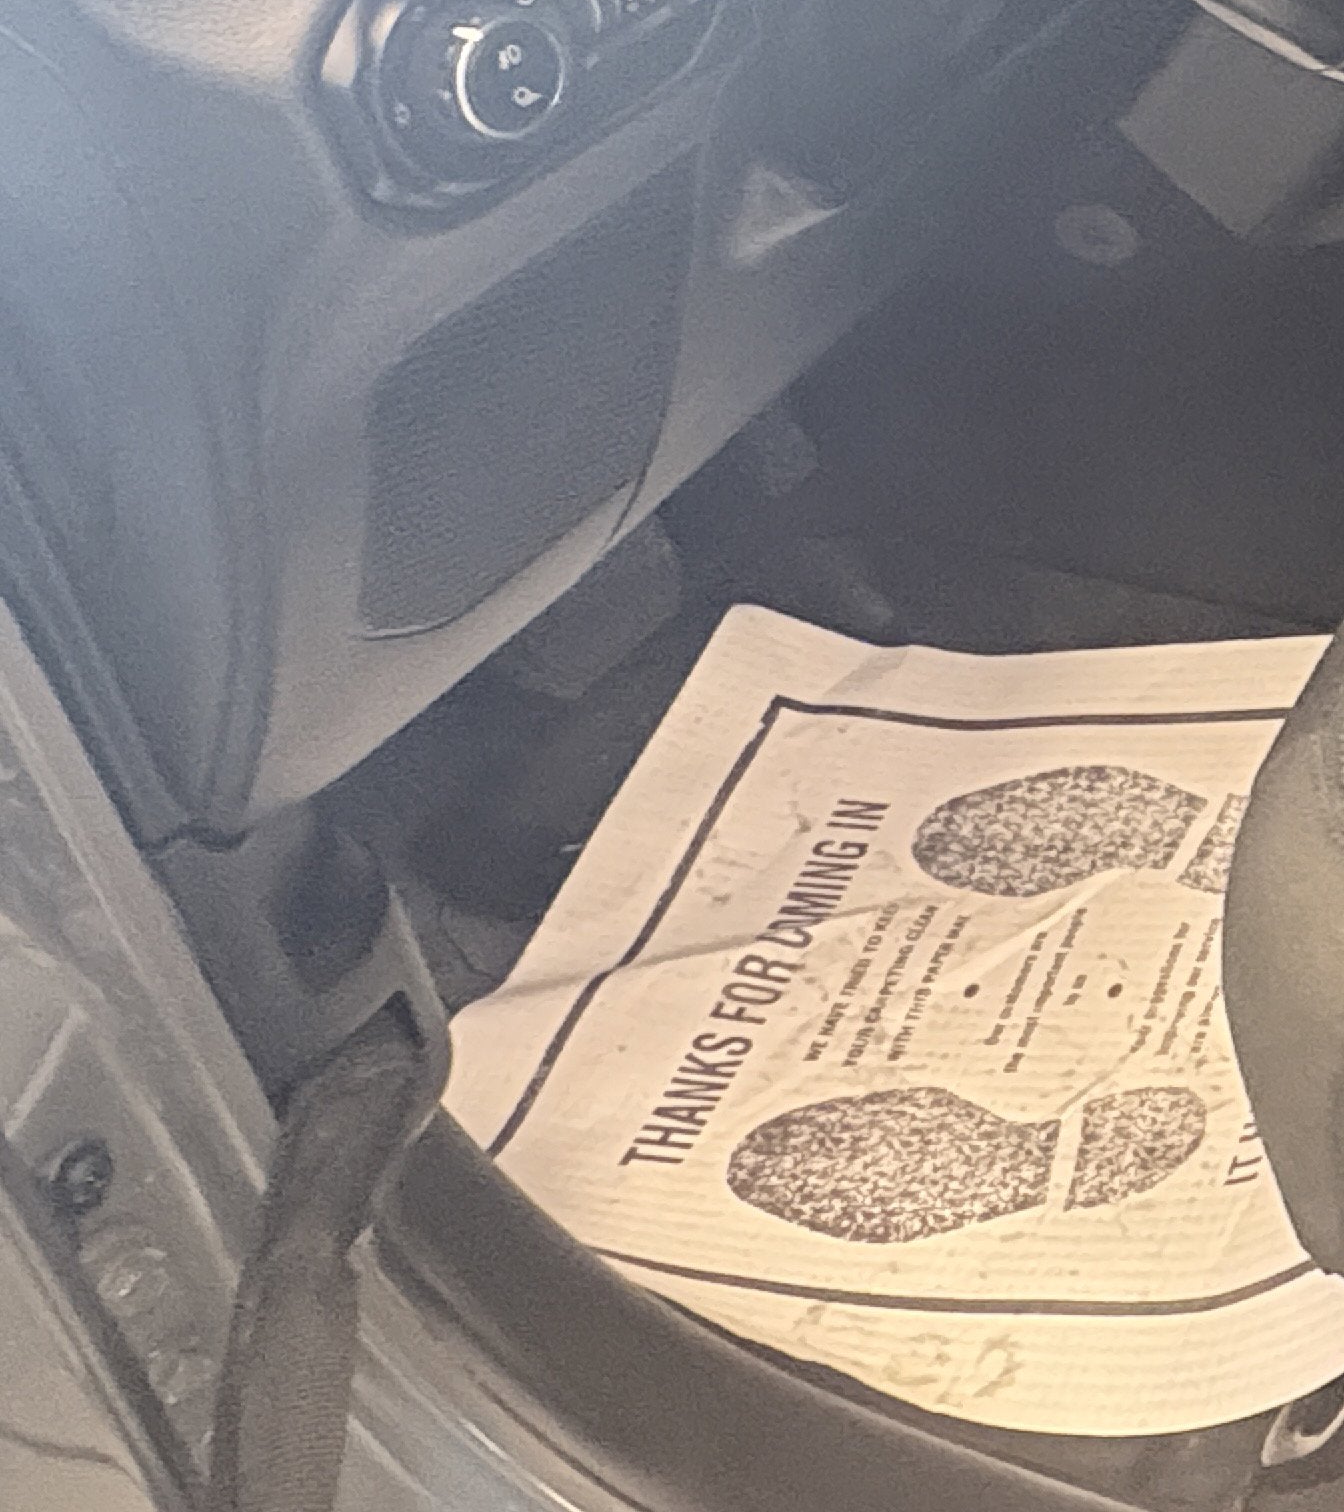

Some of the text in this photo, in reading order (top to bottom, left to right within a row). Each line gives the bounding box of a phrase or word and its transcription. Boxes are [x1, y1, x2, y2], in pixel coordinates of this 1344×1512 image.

[618, 1032, 754, 1167] THANKS
[709, 954, 806, 1025] FOR
[826, 798, 891, 830] IN
[803, 1040, 829, 1061] WE
[817, 1002, 851, 1035] HAVE
[839, 958, 873, 996] TRIED
[862, 935, 882, 953] TO
[841, 1026, 875, 1067] YOUR
[905, 904, 939, 941] CLEAN
[887, 1026, 916, 1062] WITH
[904, 987, 932, 1020] THIS
[921, 942, 954, 983] PAPER
[1223, 1154, 1264, 1187] IT
